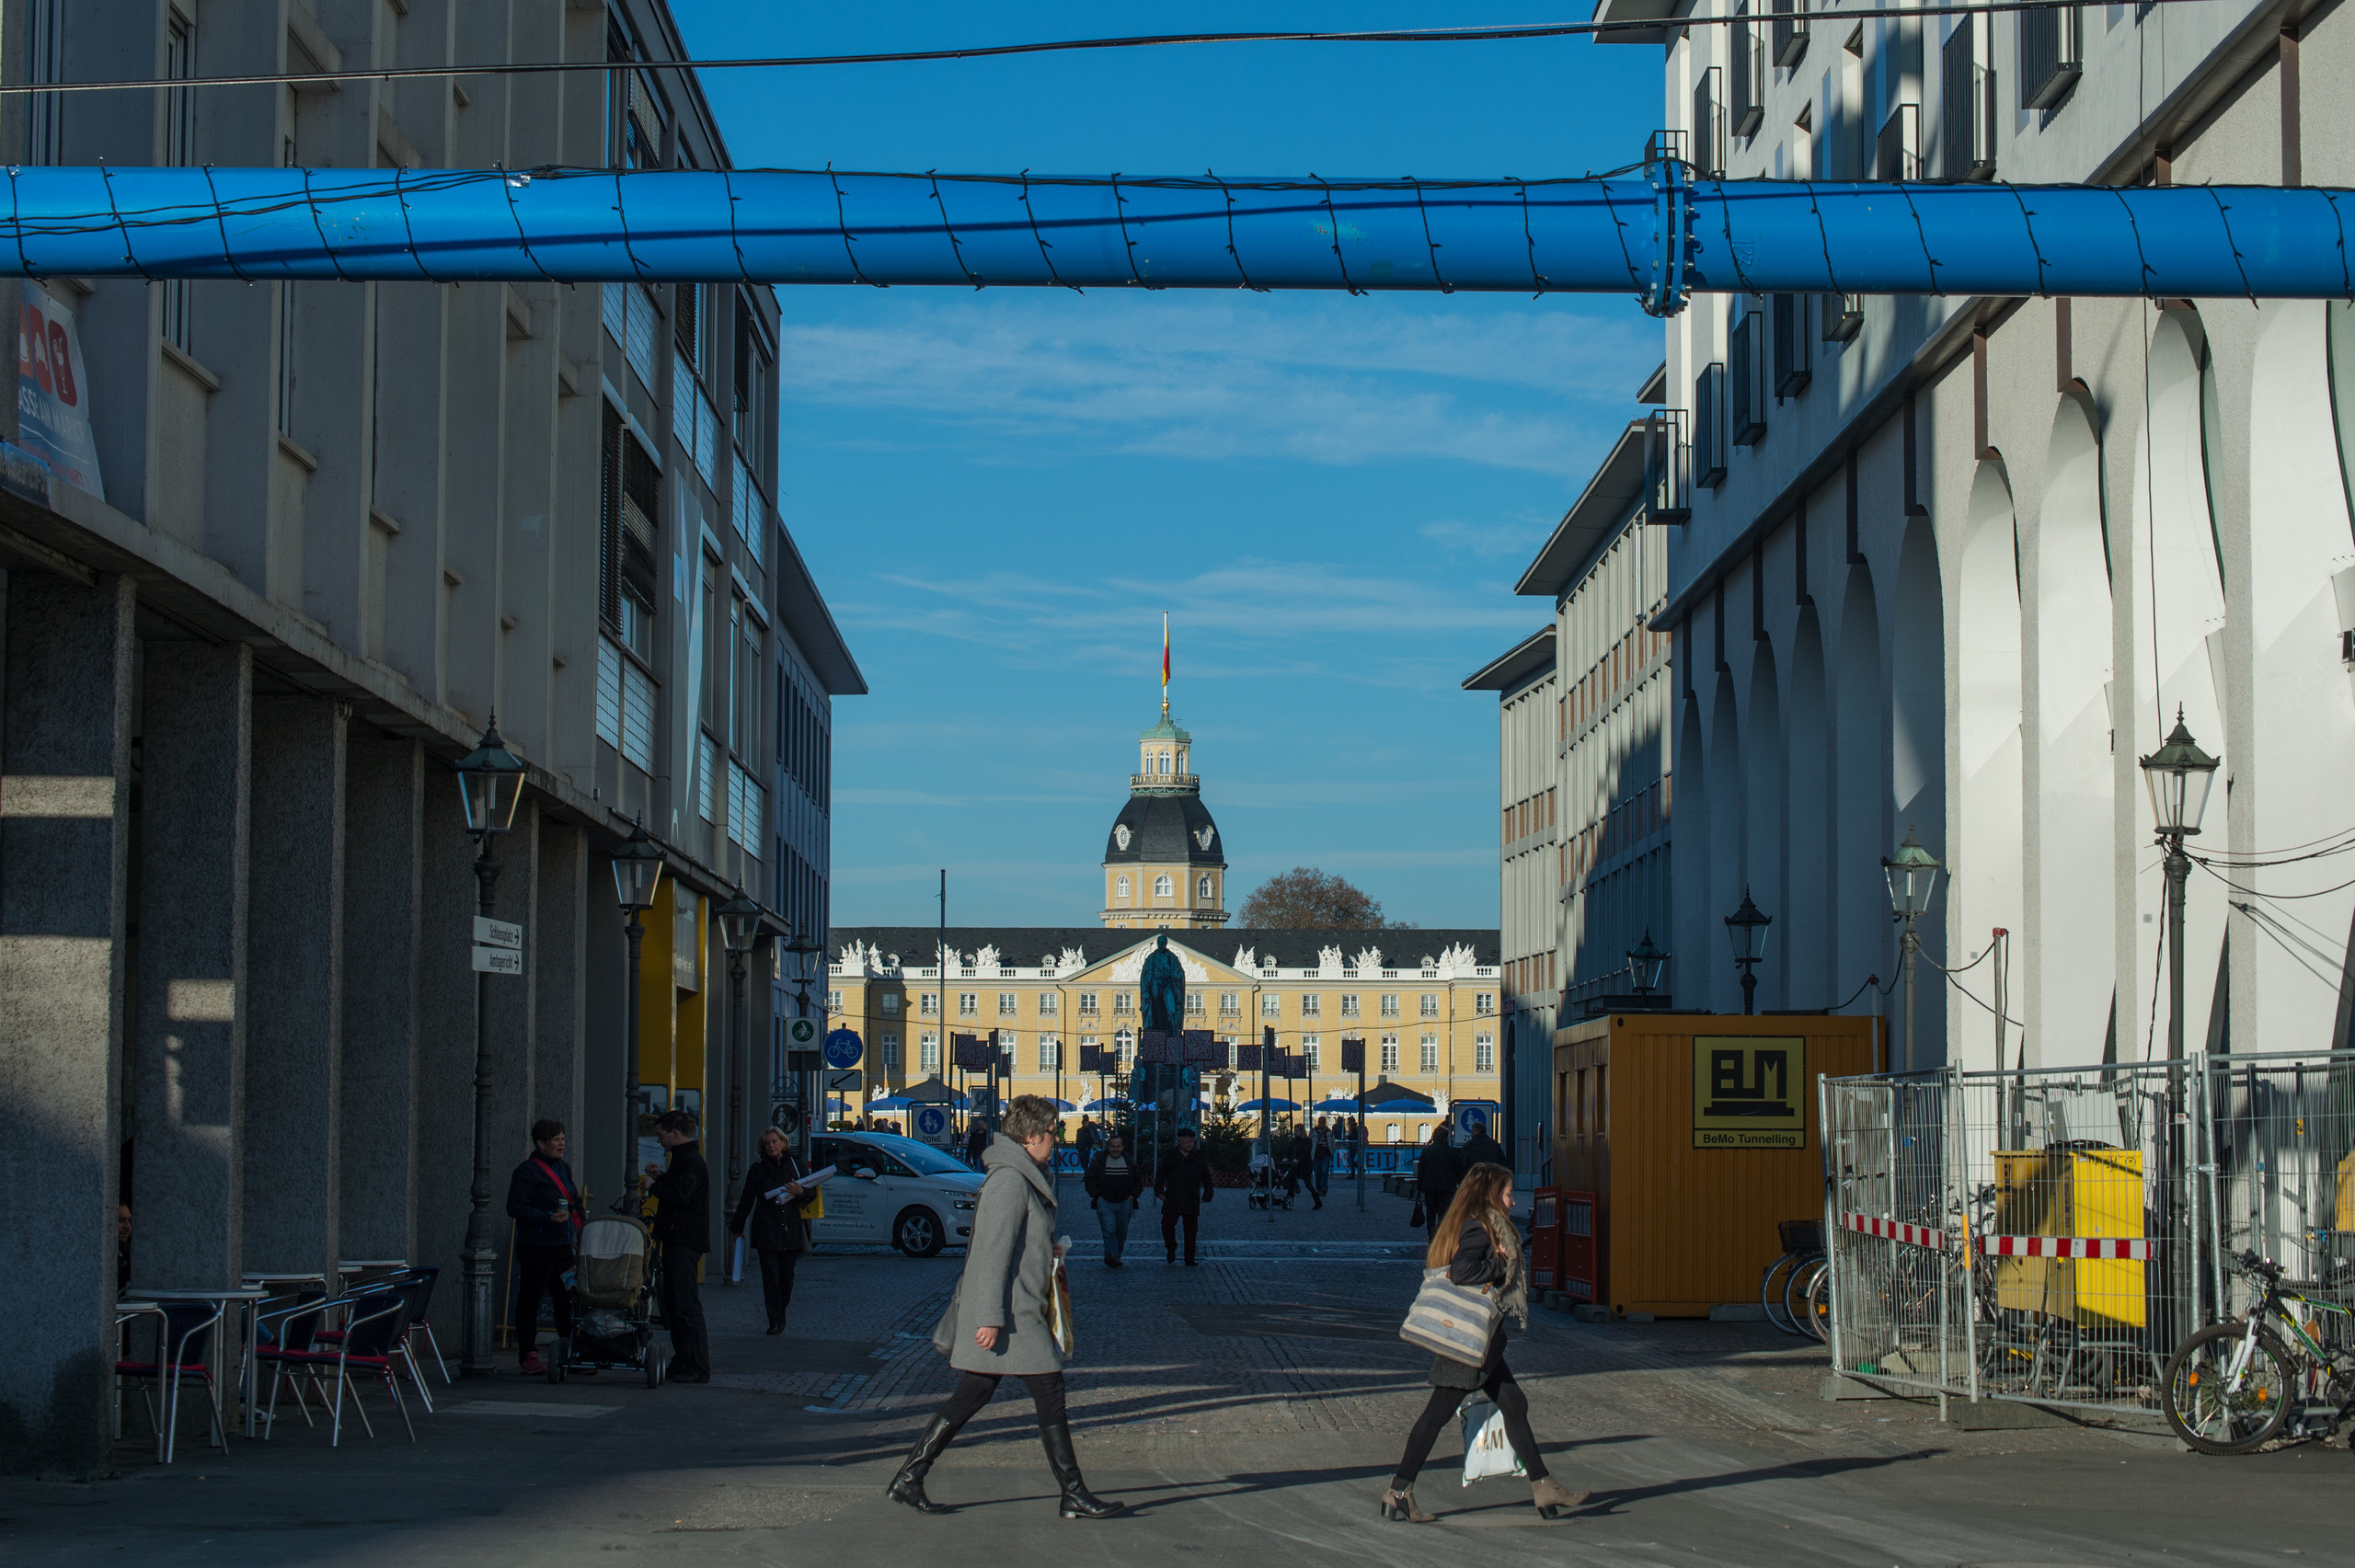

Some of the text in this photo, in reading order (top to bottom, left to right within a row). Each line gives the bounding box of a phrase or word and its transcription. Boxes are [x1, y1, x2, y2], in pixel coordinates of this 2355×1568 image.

[489, 924, 513, 944] Schlossplatz
[489, 953, 513, 972] Amtsgericht
[1703, 1133, 1796, 1146] BeMo Tunnelling
